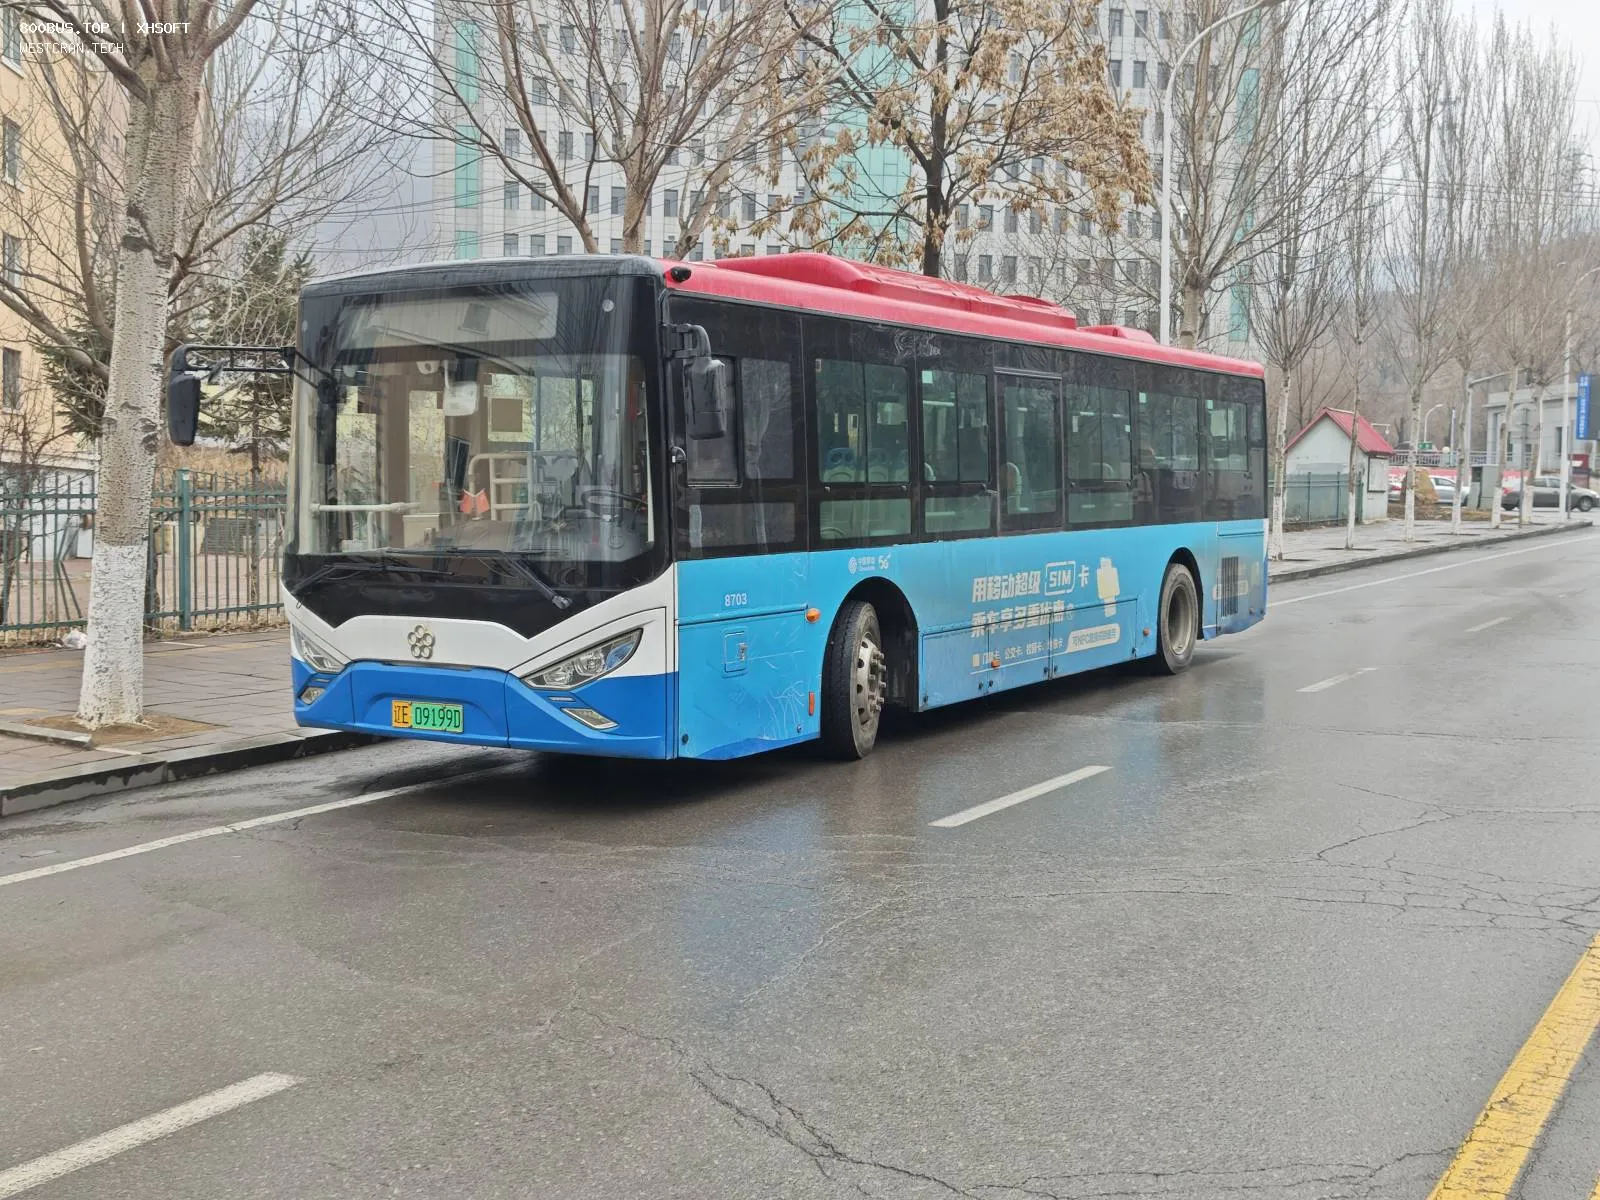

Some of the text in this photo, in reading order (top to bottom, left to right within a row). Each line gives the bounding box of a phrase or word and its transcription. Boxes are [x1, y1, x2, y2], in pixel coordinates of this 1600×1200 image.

[972, 565, 1090, 603] 用移动超级 SIM 卡
[724, 593, 748, 607] 8703
